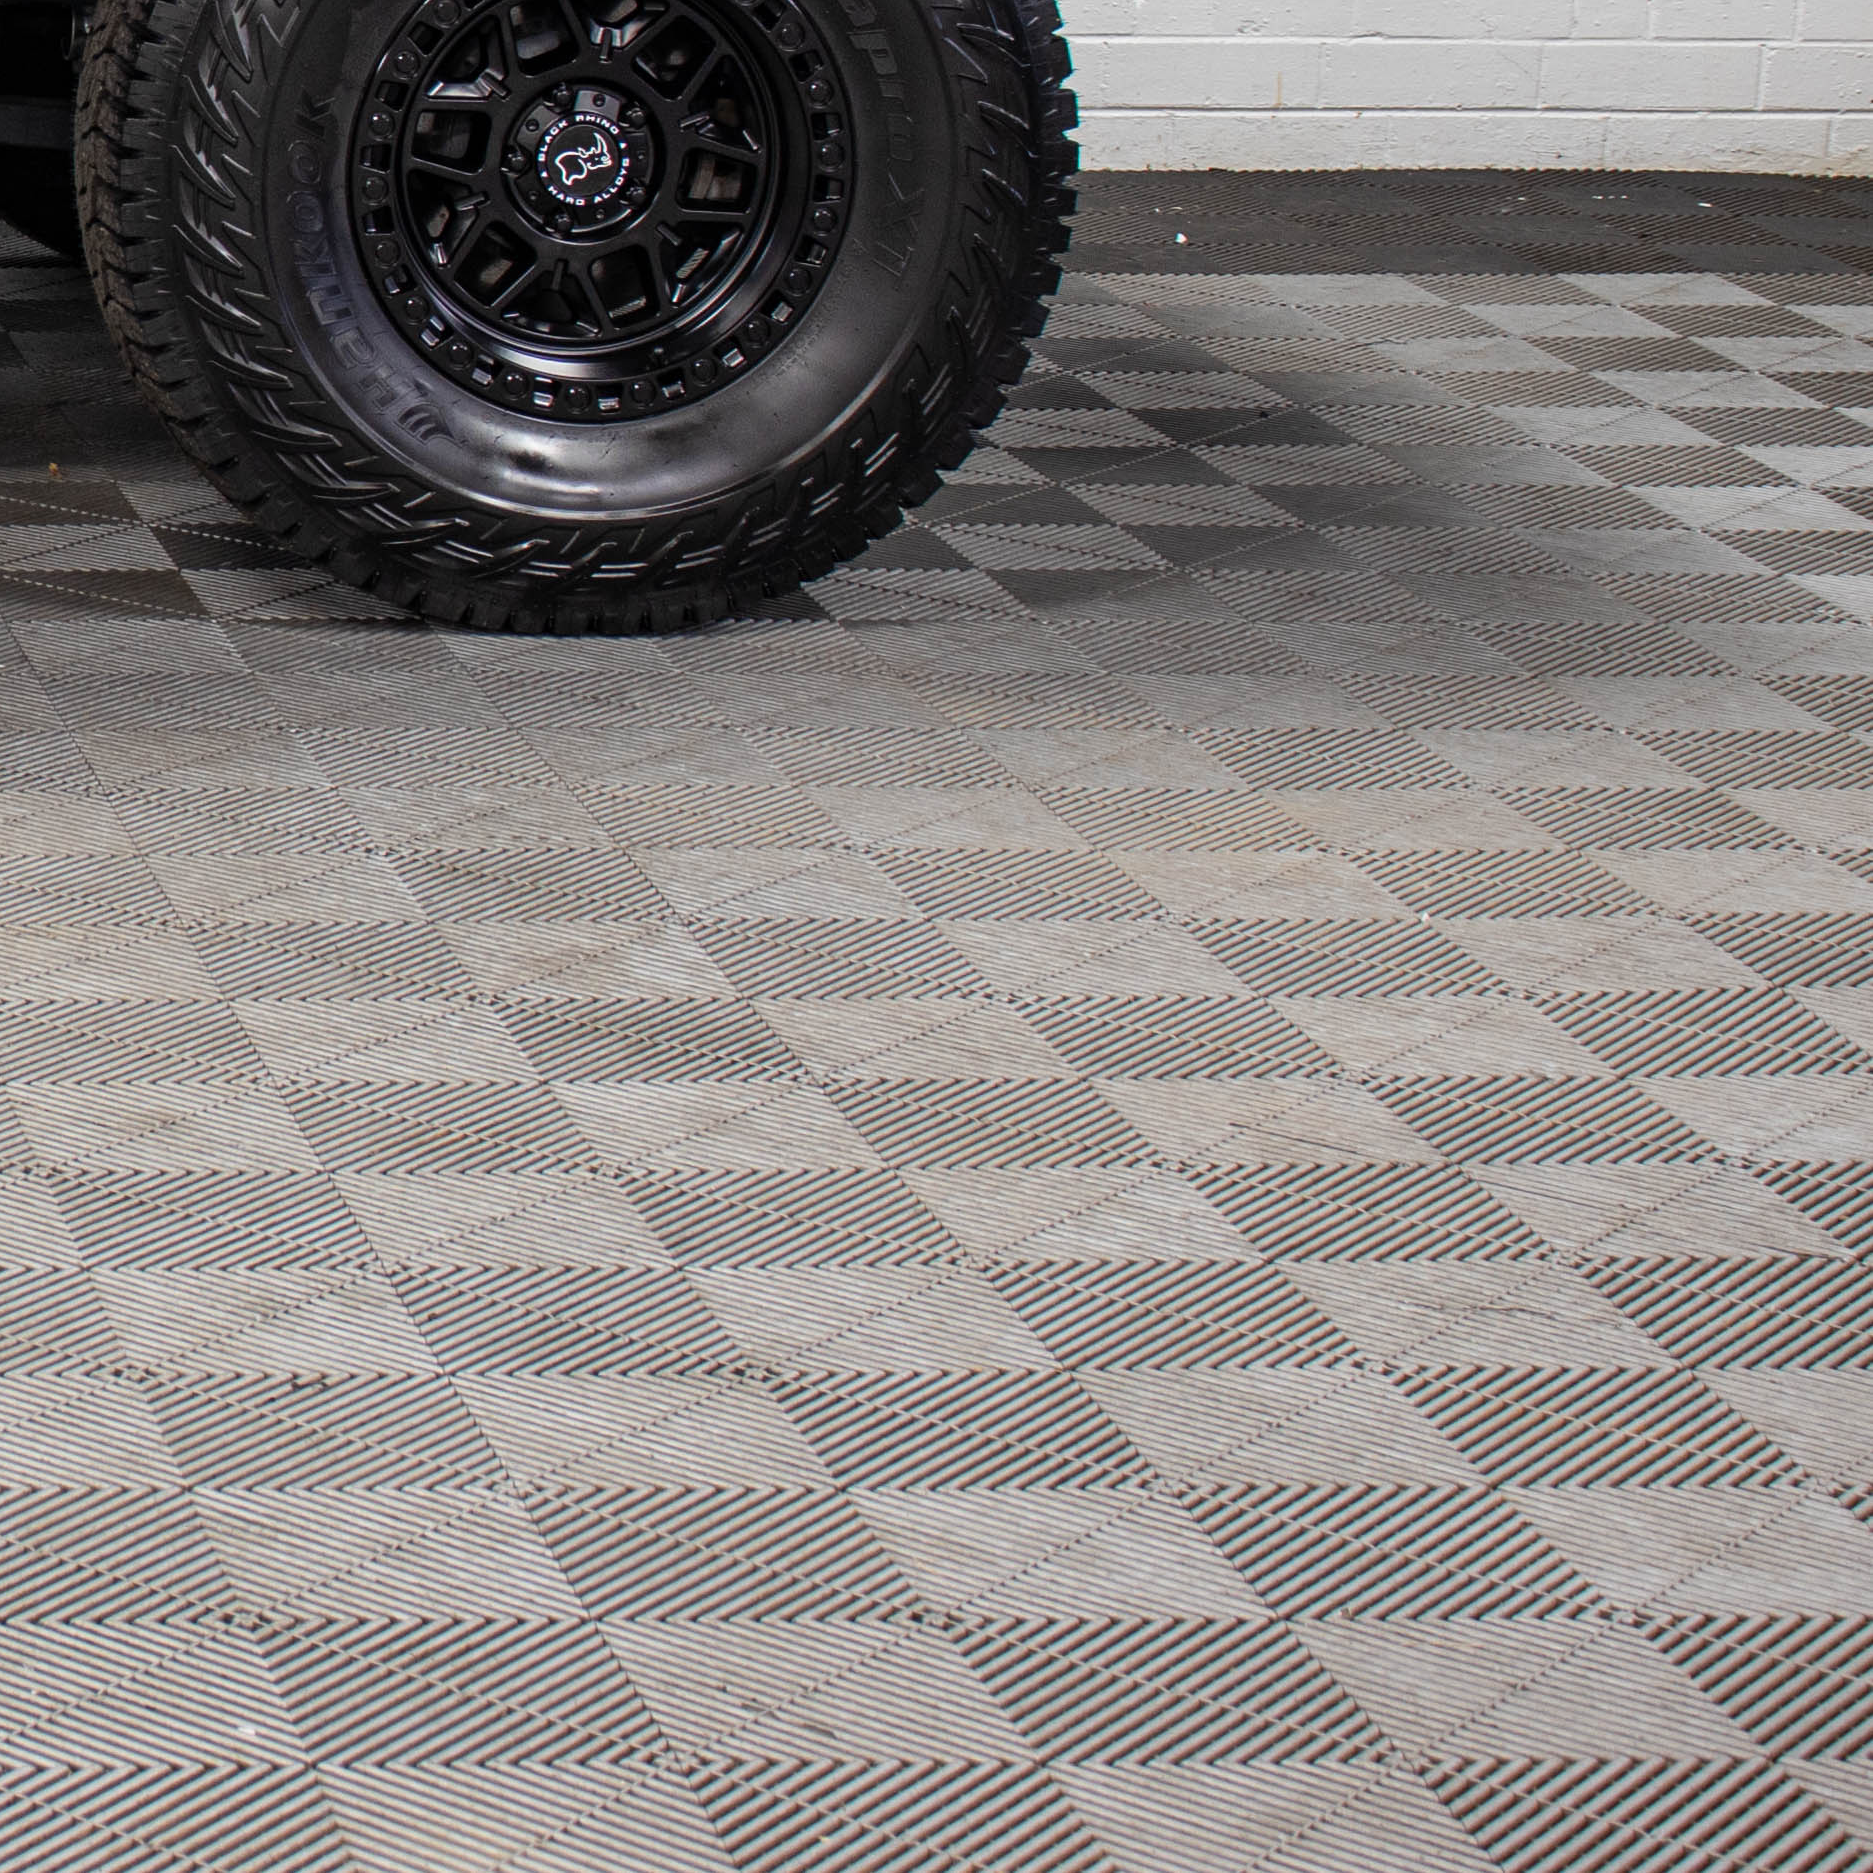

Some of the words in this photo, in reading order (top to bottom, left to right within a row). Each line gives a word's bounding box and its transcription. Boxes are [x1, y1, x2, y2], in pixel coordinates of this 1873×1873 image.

[538, 120, 568, 161] BLACK
[575, 115, 620, 134] RHINO
[548, 186, 585, 205] HARD
[594, 158, 630, 203] ALLOYS
